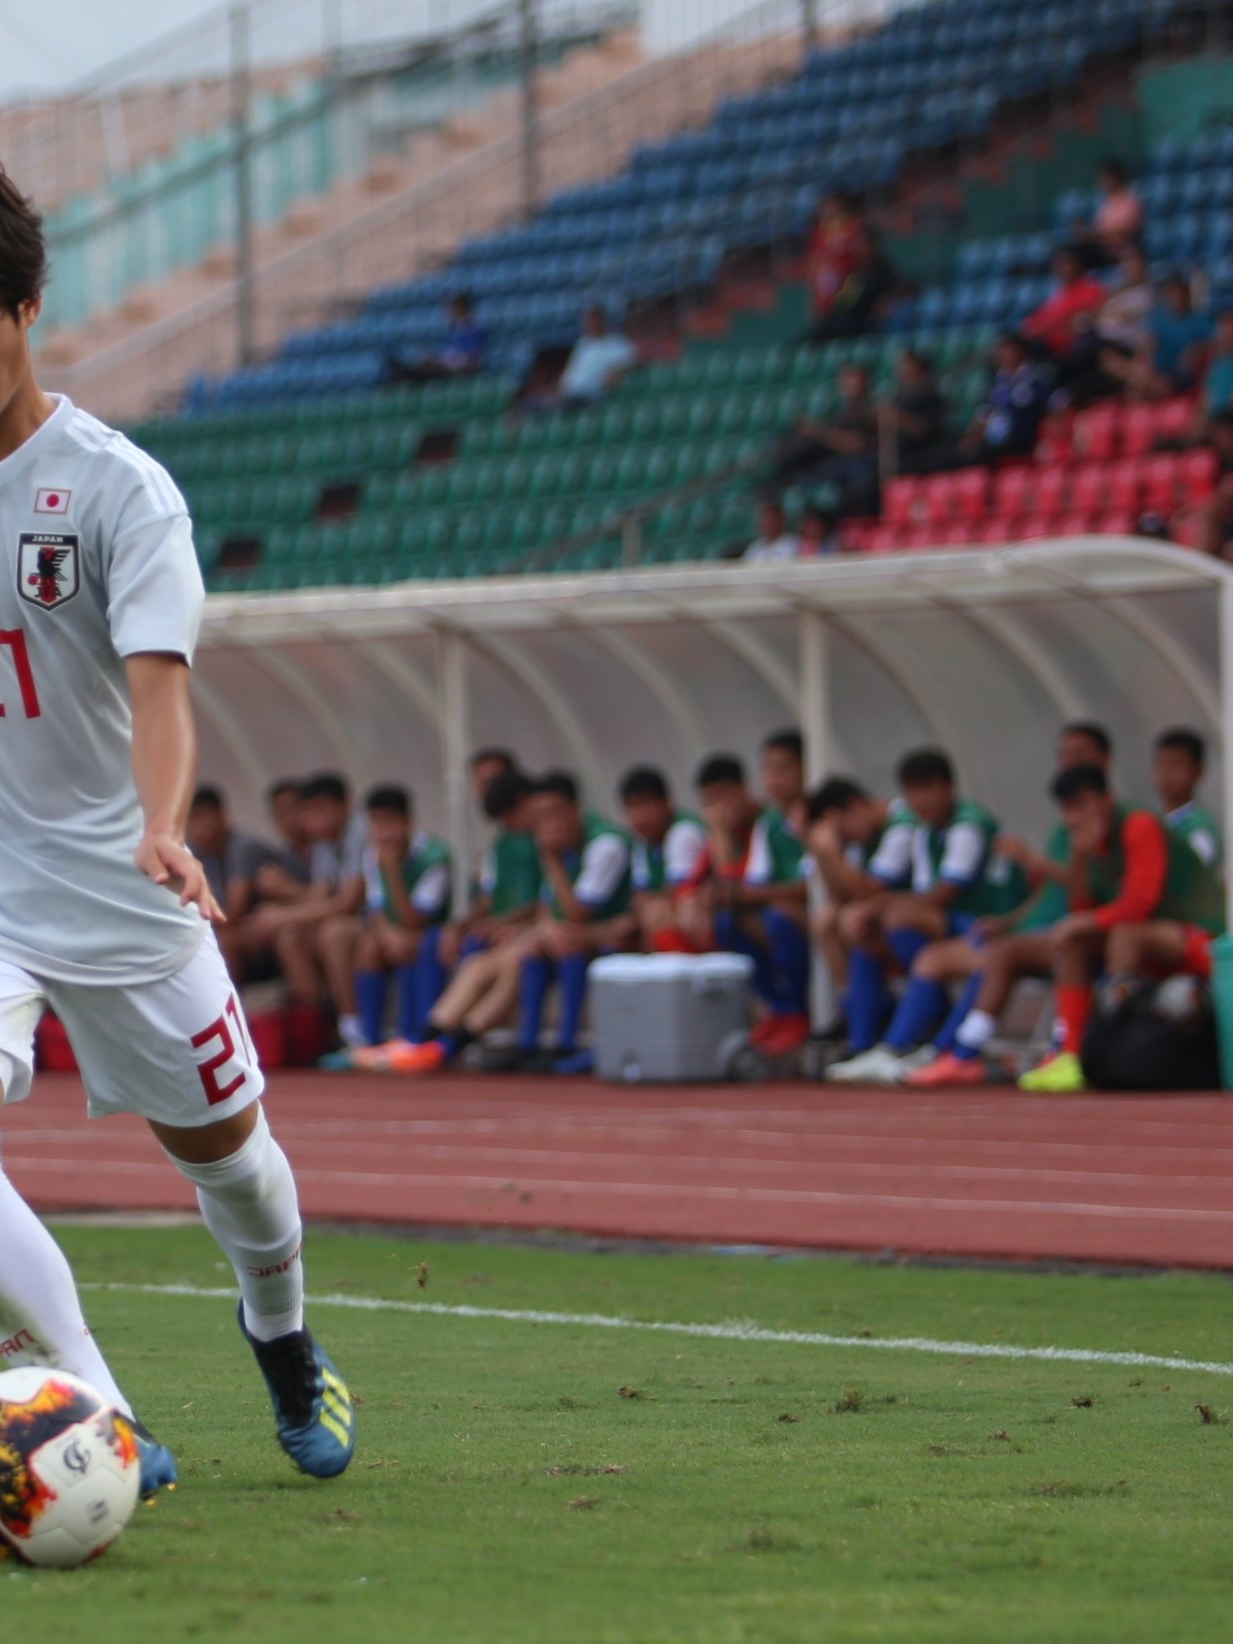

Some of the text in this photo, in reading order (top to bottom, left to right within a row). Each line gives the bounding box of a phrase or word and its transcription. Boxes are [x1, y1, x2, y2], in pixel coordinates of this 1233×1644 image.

[32, 535, 63, 543] JAPAN
[34, 586, 63, 598] JA
[190, 991, 252, 1106] 21
